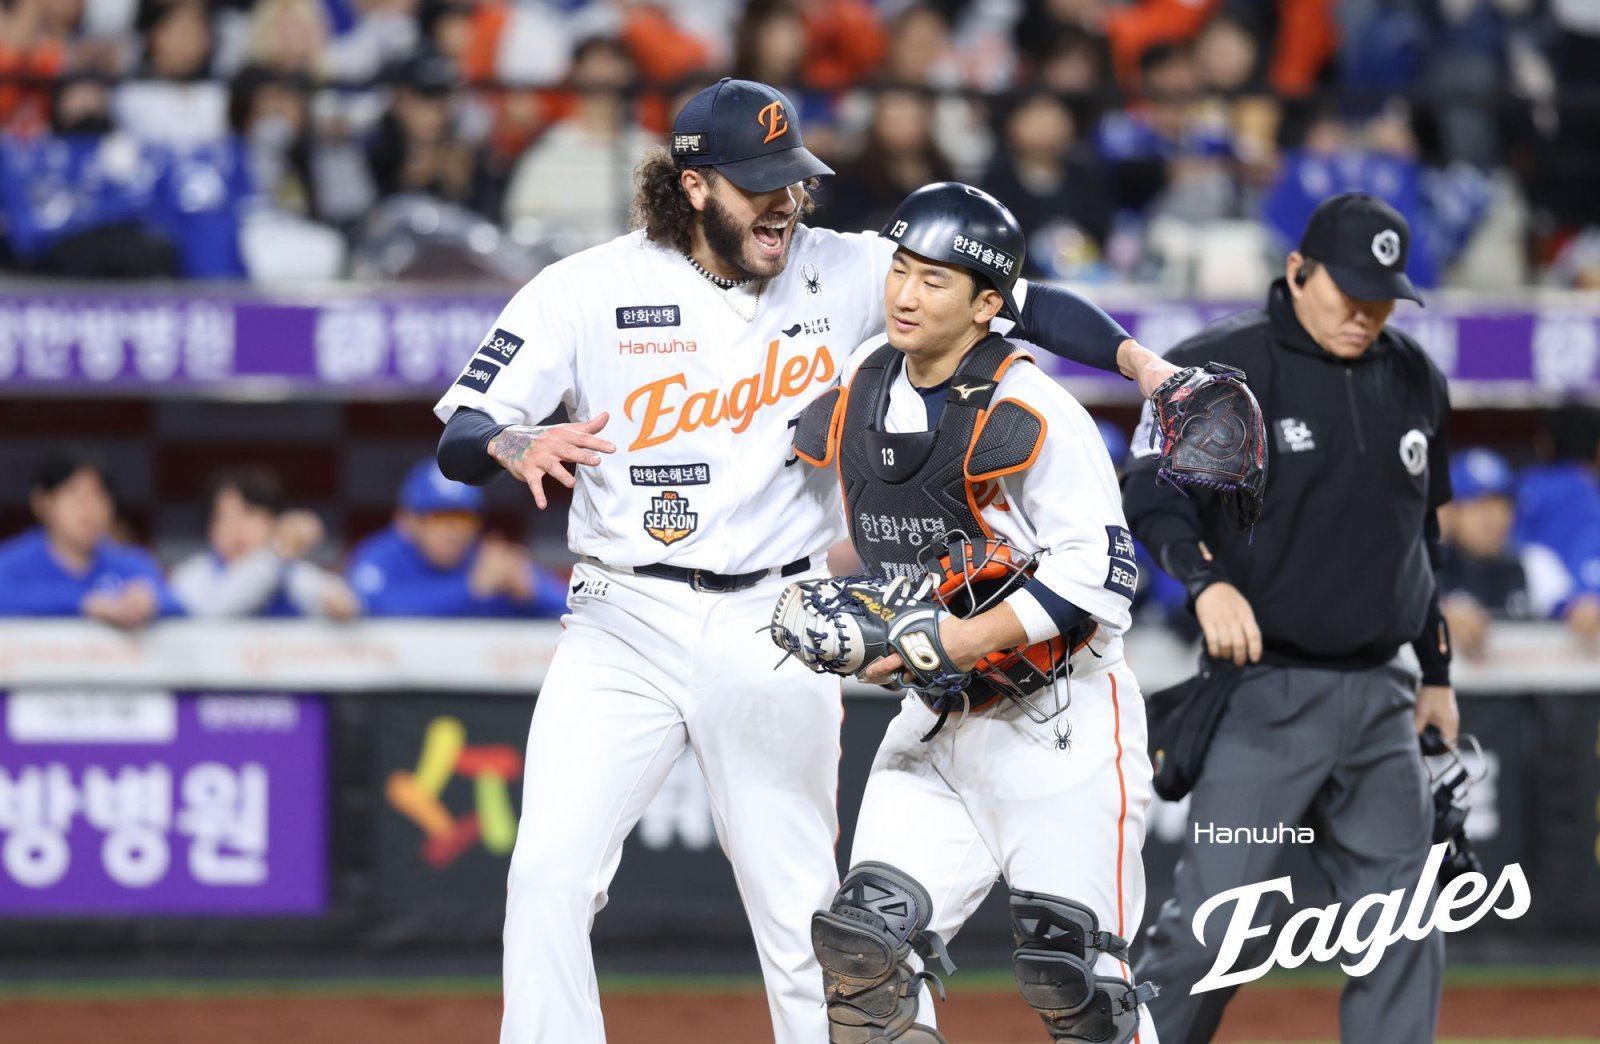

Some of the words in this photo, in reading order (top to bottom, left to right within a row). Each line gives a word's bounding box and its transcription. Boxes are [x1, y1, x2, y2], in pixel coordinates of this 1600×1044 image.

[889, 220, 909, 239] 13
[953, 235, 1014, 276] 한화솔루션
[622, 308, 676, 325] 한화생명
[803, 317, 830, 329] LIFE
[805, 324, 831, 335] PLUS
[619, 339, 698, 355] Hanwha
[623, 339, 835, 453] Eagles
[881, 447, 895, 466] 13
[632, 466, 708, 484] 한화손해보험
[654, 499, 687, 514] POST
[645, 513, 696, 530] SEASON
[860, 512, 947, 546] 한화생명
[583, 587, 607, 597] PLUS
[586, 580, 610, 589] LIFE
